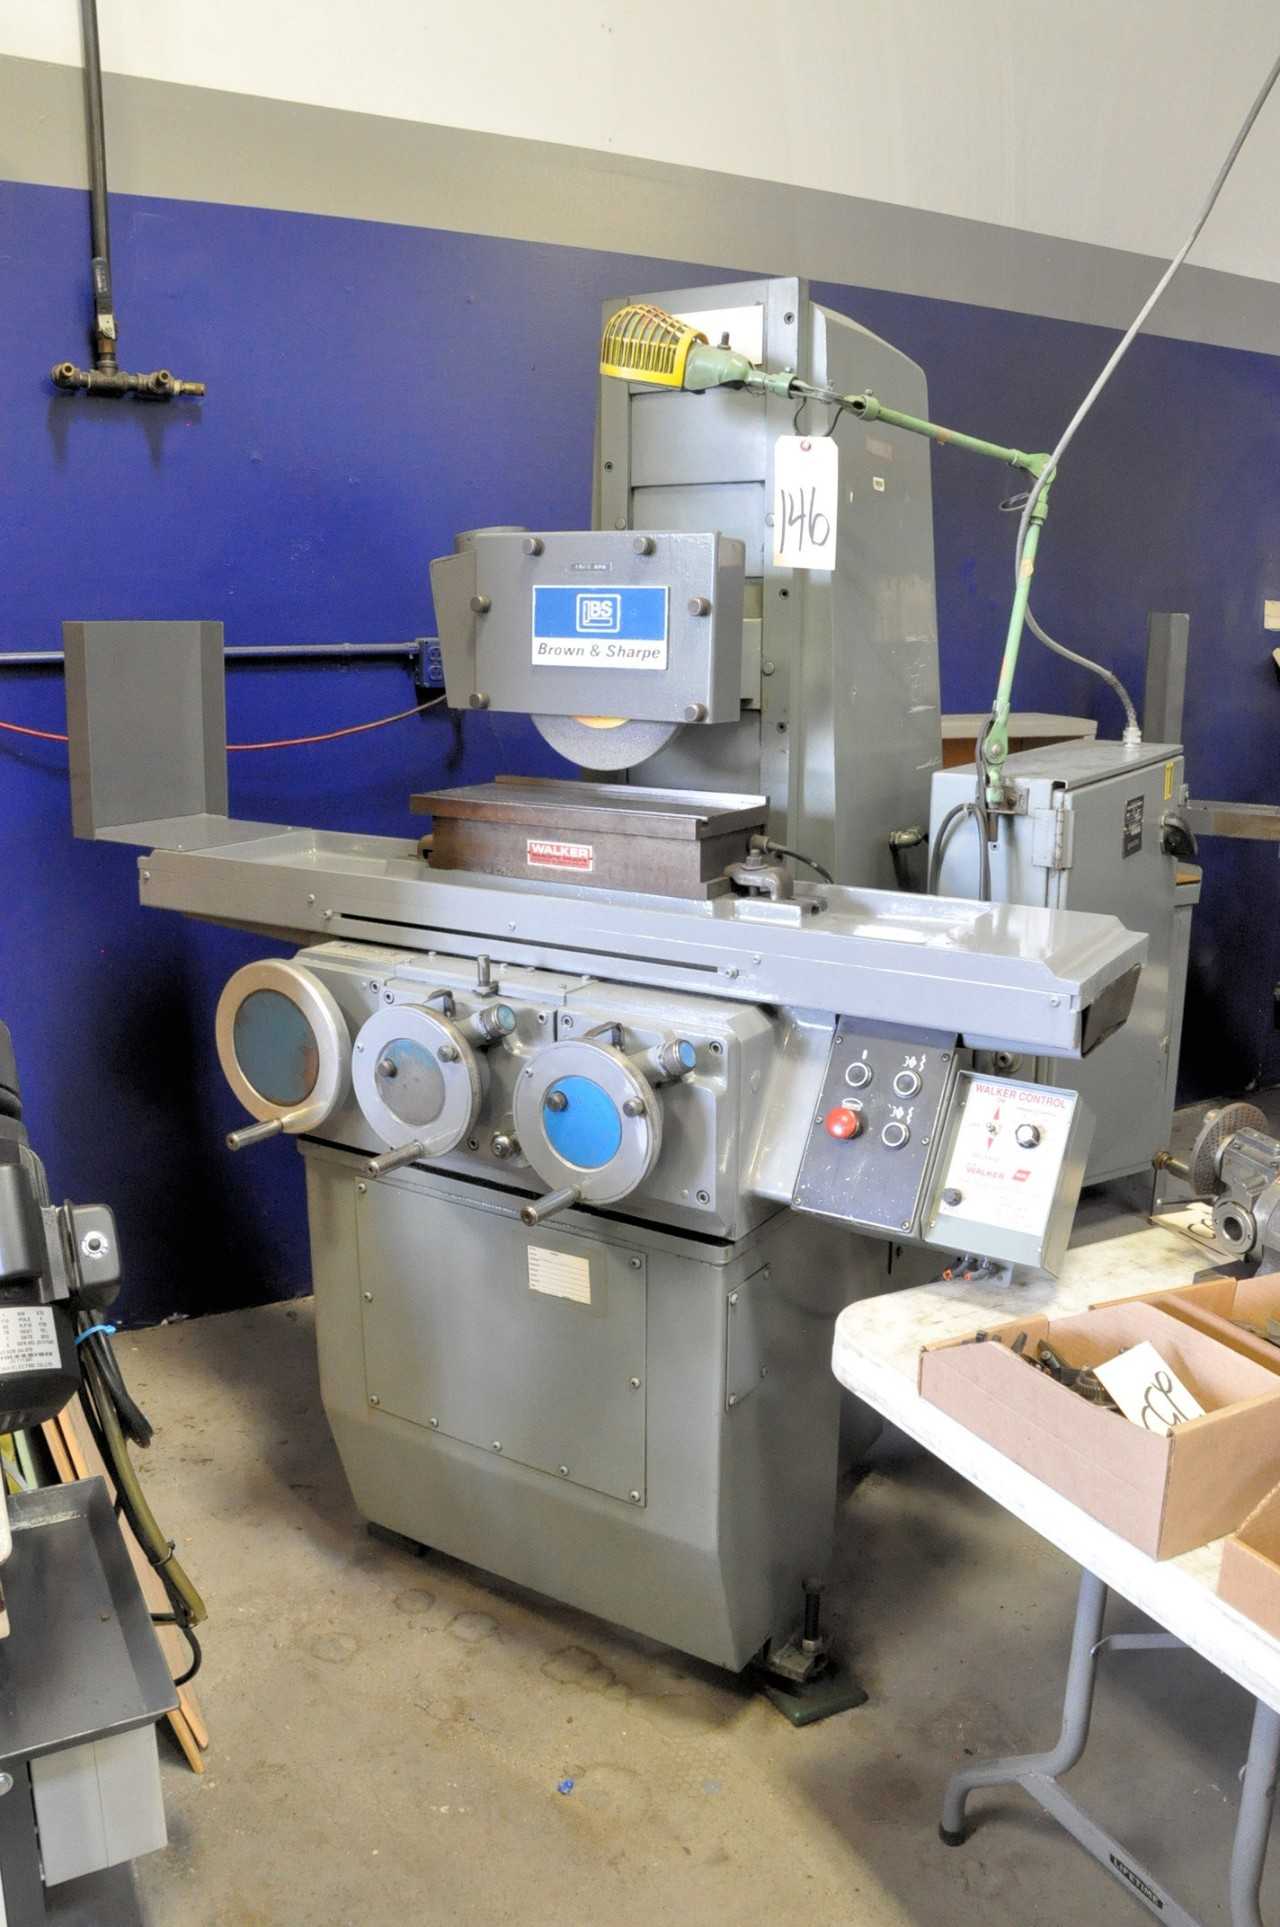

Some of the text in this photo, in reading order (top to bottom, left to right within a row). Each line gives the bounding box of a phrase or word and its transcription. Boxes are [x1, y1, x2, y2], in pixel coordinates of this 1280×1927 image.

[779, 486, 831, 554] 146
[537, 642, 662, 662] Brown & Sharpe
[531, 843, 589, 859] WALKER
[975, 1083, 1066, 1109] WALKER CONTROL
